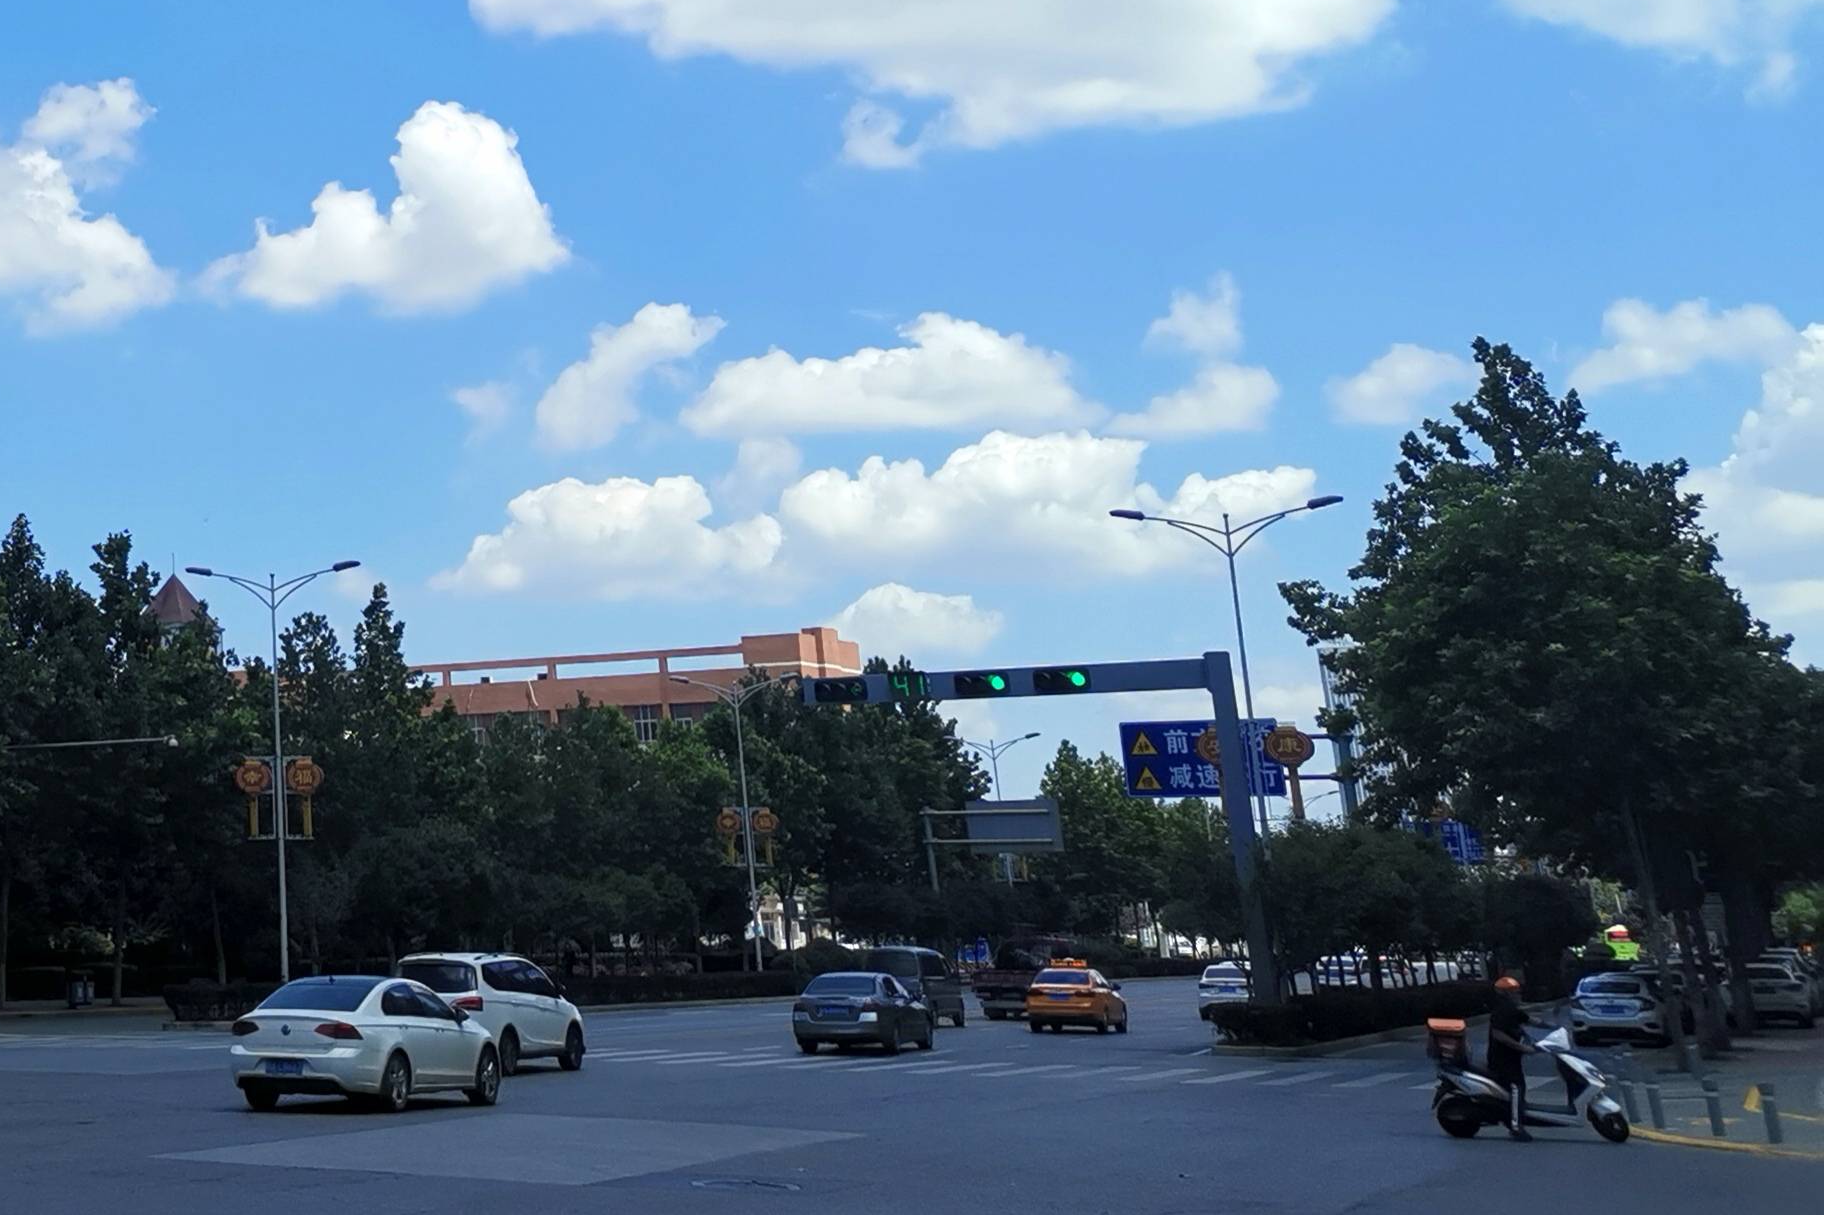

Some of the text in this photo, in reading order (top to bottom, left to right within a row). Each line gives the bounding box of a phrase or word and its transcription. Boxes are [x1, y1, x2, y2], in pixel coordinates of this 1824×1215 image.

[892, 674, 925, 697] 41
[1277, 737, 1302, 753] 康
[1168, 762, 1277, 790] 减速行
